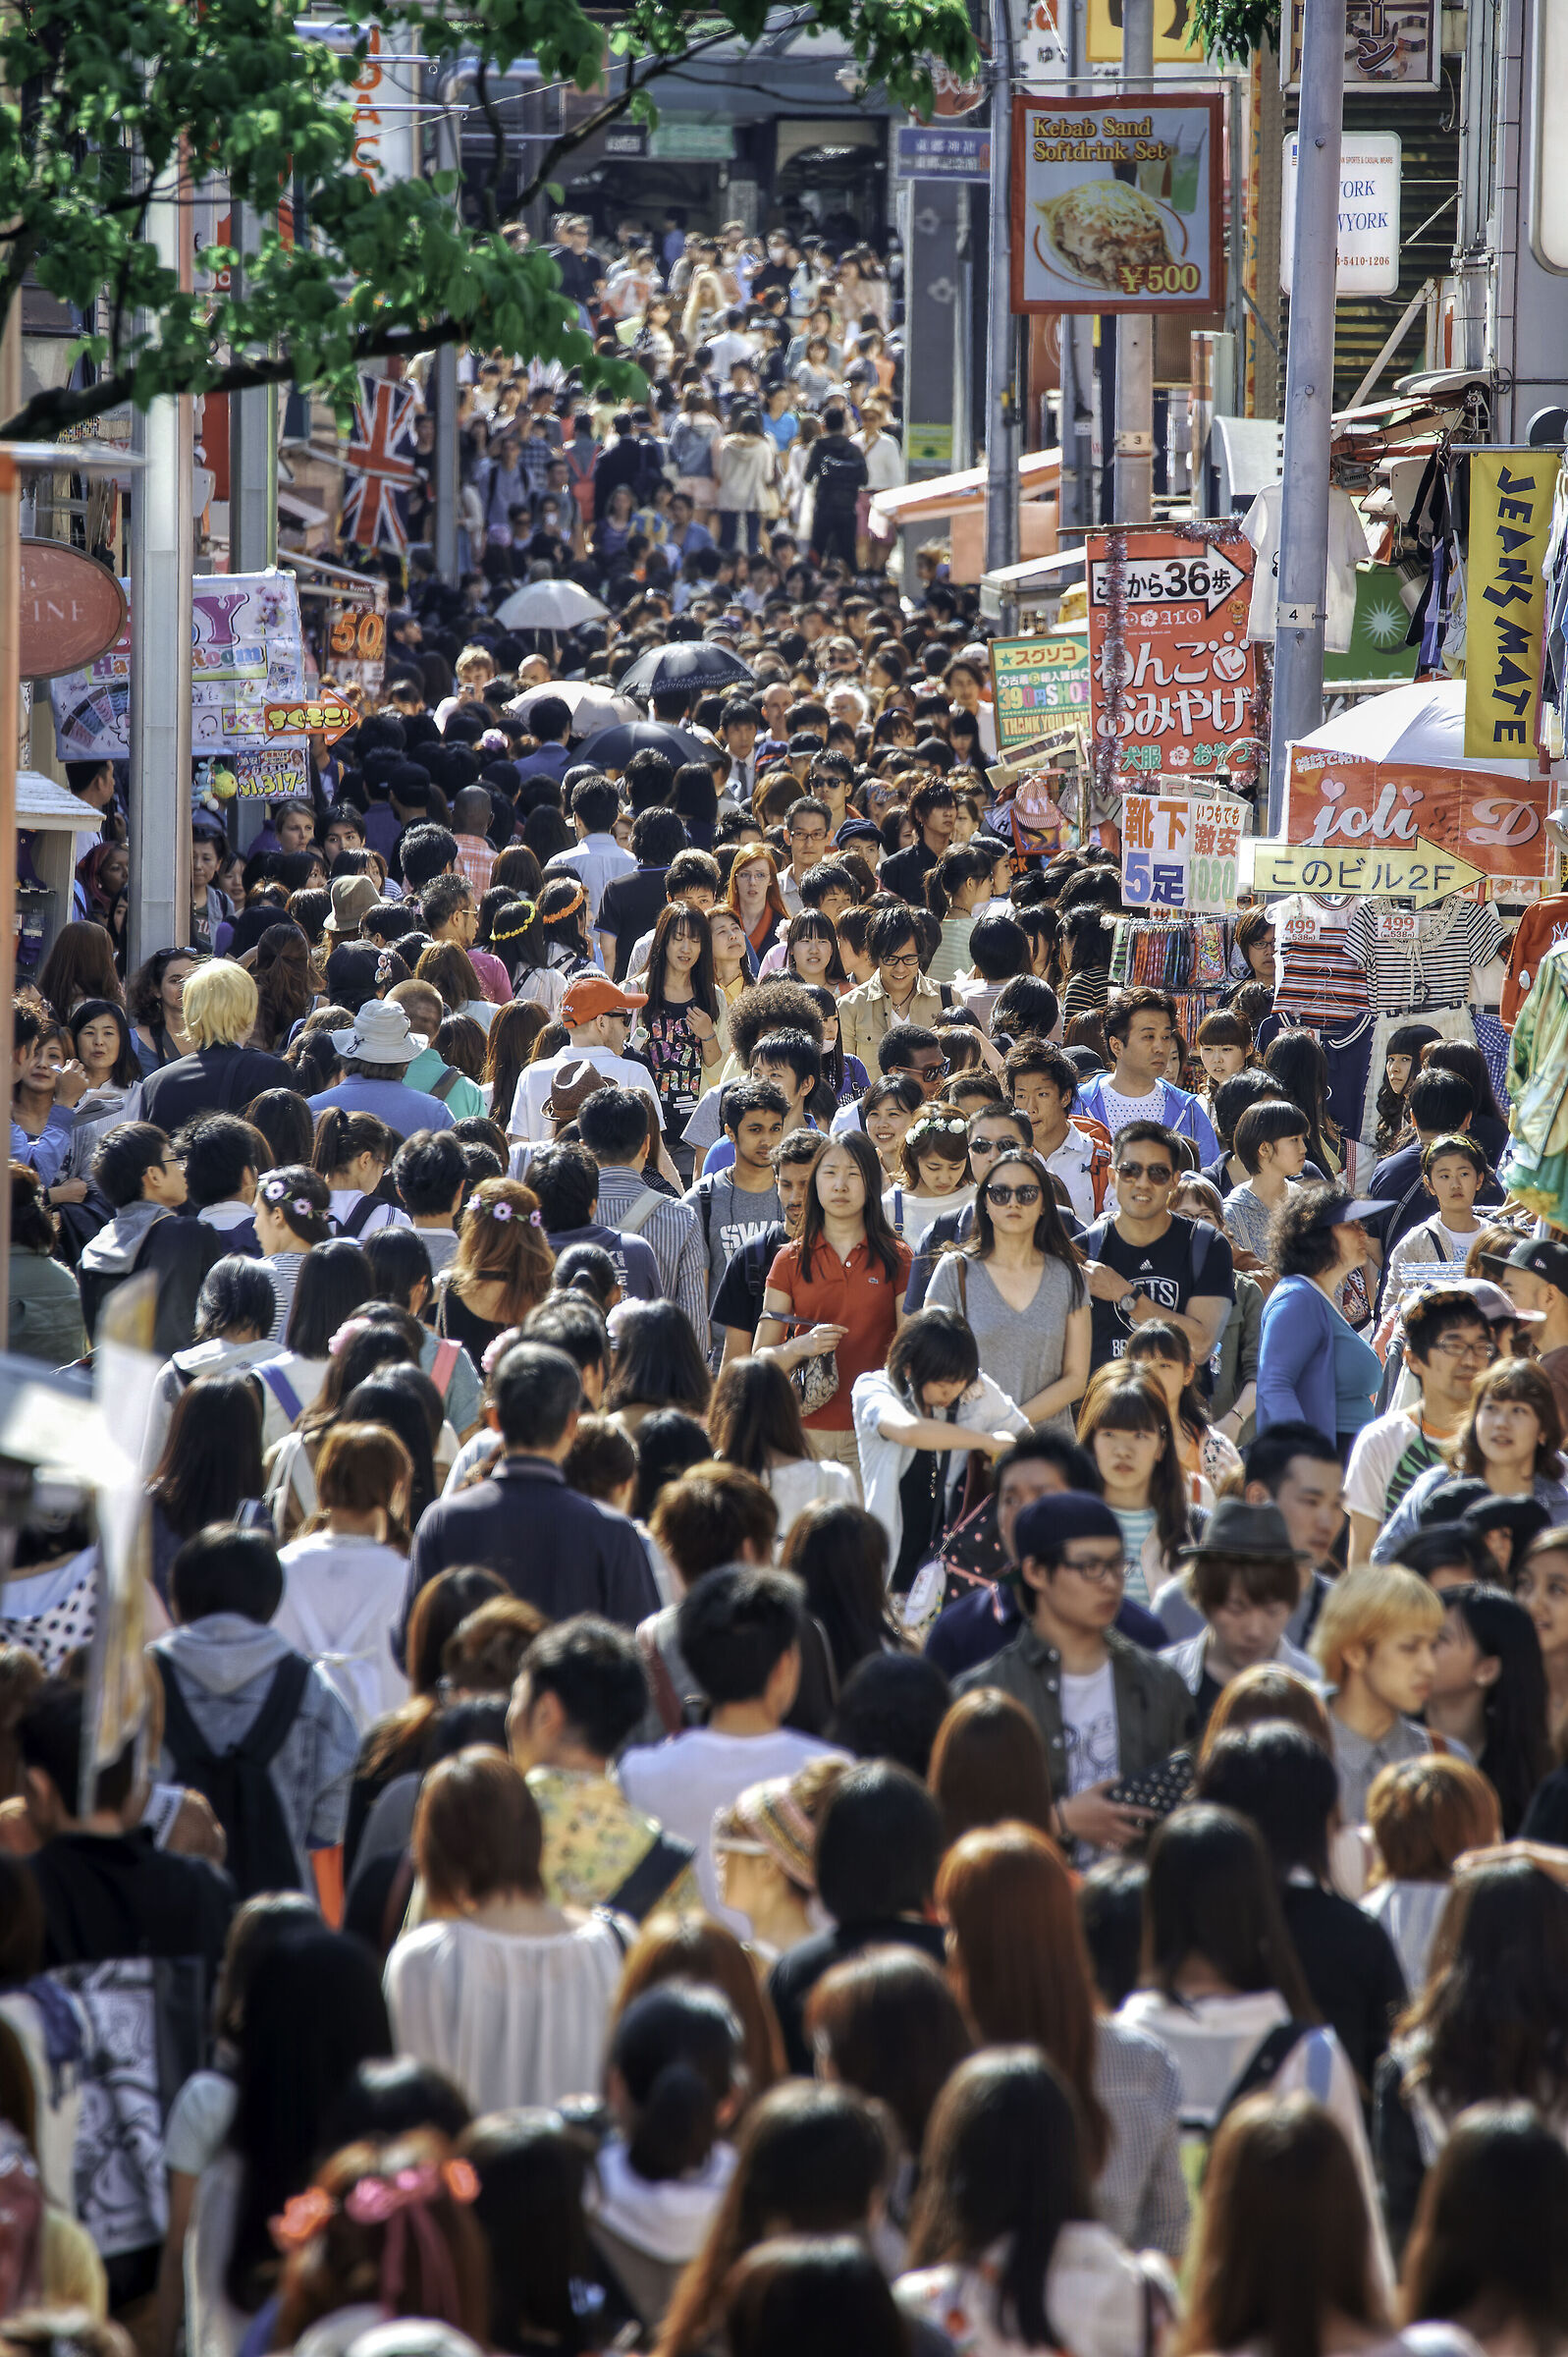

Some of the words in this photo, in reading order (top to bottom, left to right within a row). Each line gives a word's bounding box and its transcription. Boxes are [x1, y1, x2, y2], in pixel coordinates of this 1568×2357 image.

[1033, 116, 1097, 137] Kebab
[1102, 115, 1153, 137] Sand
[1033, 140, 1128, 162] Softdrink
[1133, 140, 1169, 161] Set
[1117, 263, 1201, 295] ¥500
[1482, 466, 1537, 609] JEANS
[1096, 561, 1231, 600] こから36歩
[20, 599, 88, 623] INE
[191, 592, 249, 648] Y
[1288, 609, 1299, 621] 4
[331, 612, 385, 653] 50
[1015, 645, 1076, 666] スグソコ
[1491, 615, 1534, 744] MATE
[1120, 743, 1162, 773] 犬服
[1124, 795, 1189, 851] 靴下
[1196, 803, 1240, 826] いつもでも
[1300, 783, 1420, 848] joli
[1194, 823, 1241, 858] 激安
[1124, 851, 1186, 906] 5足
[1271, 856, 1456, 892] このビル2F
[1284, 919, 1316, 934] 499
[1382, 916, 1416, 931] 499
